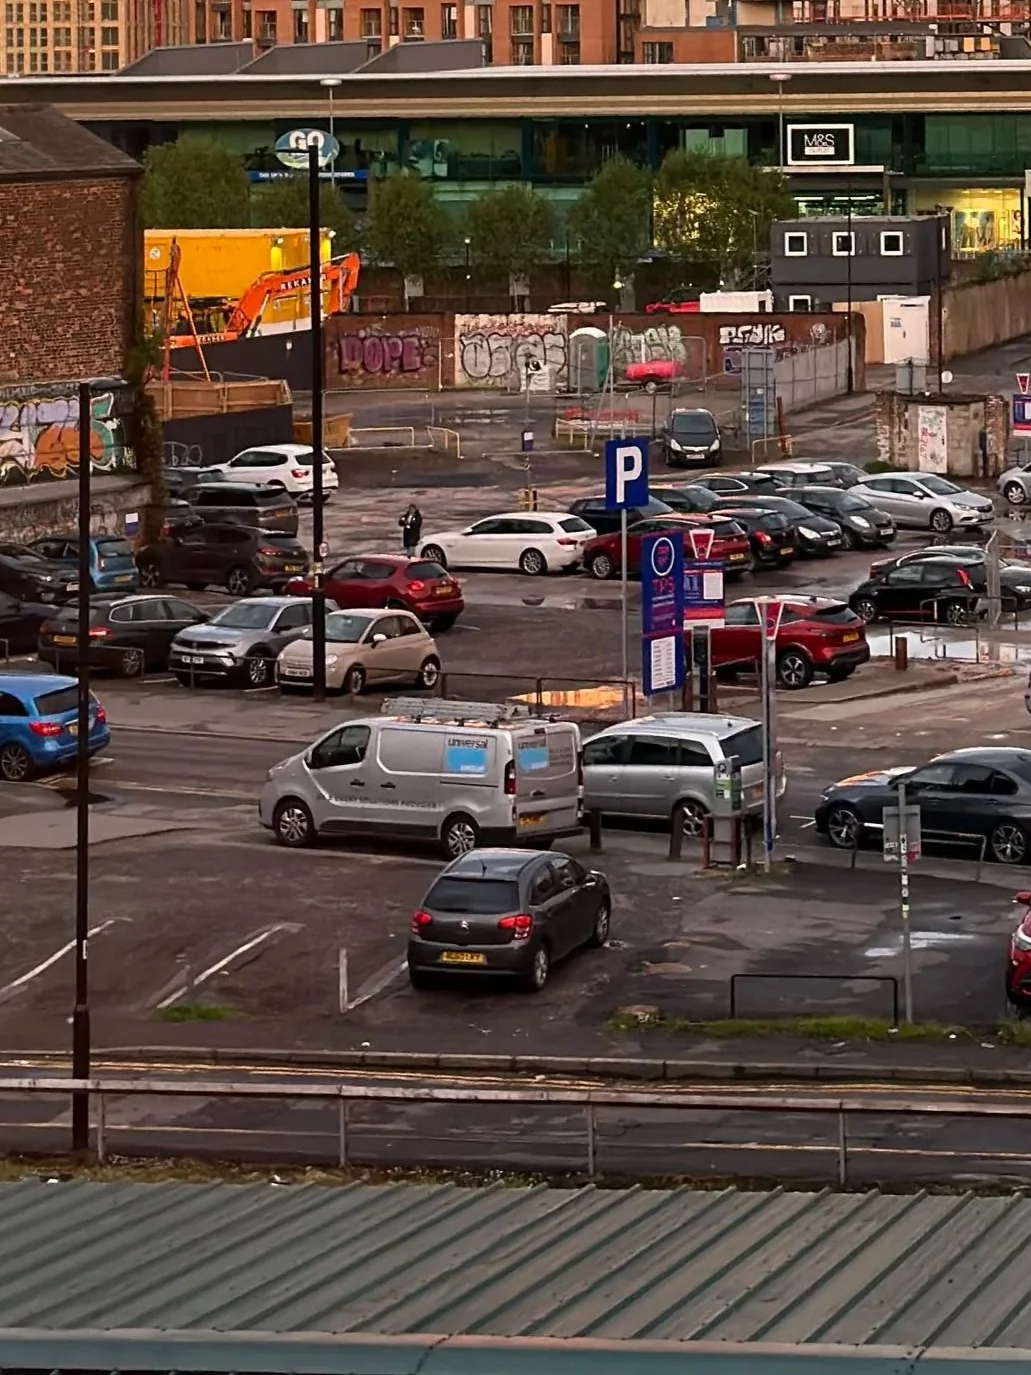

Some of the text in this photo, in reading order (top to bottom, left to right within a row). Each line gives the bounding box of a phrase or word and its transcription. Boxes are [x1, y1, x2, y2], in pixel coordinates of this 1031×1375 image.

[289, 130, 325, 151] GO
[804, 133, 835, 146] M&S
[616, 445, 643, 504] P
[448, 738, 489, 749] universal
